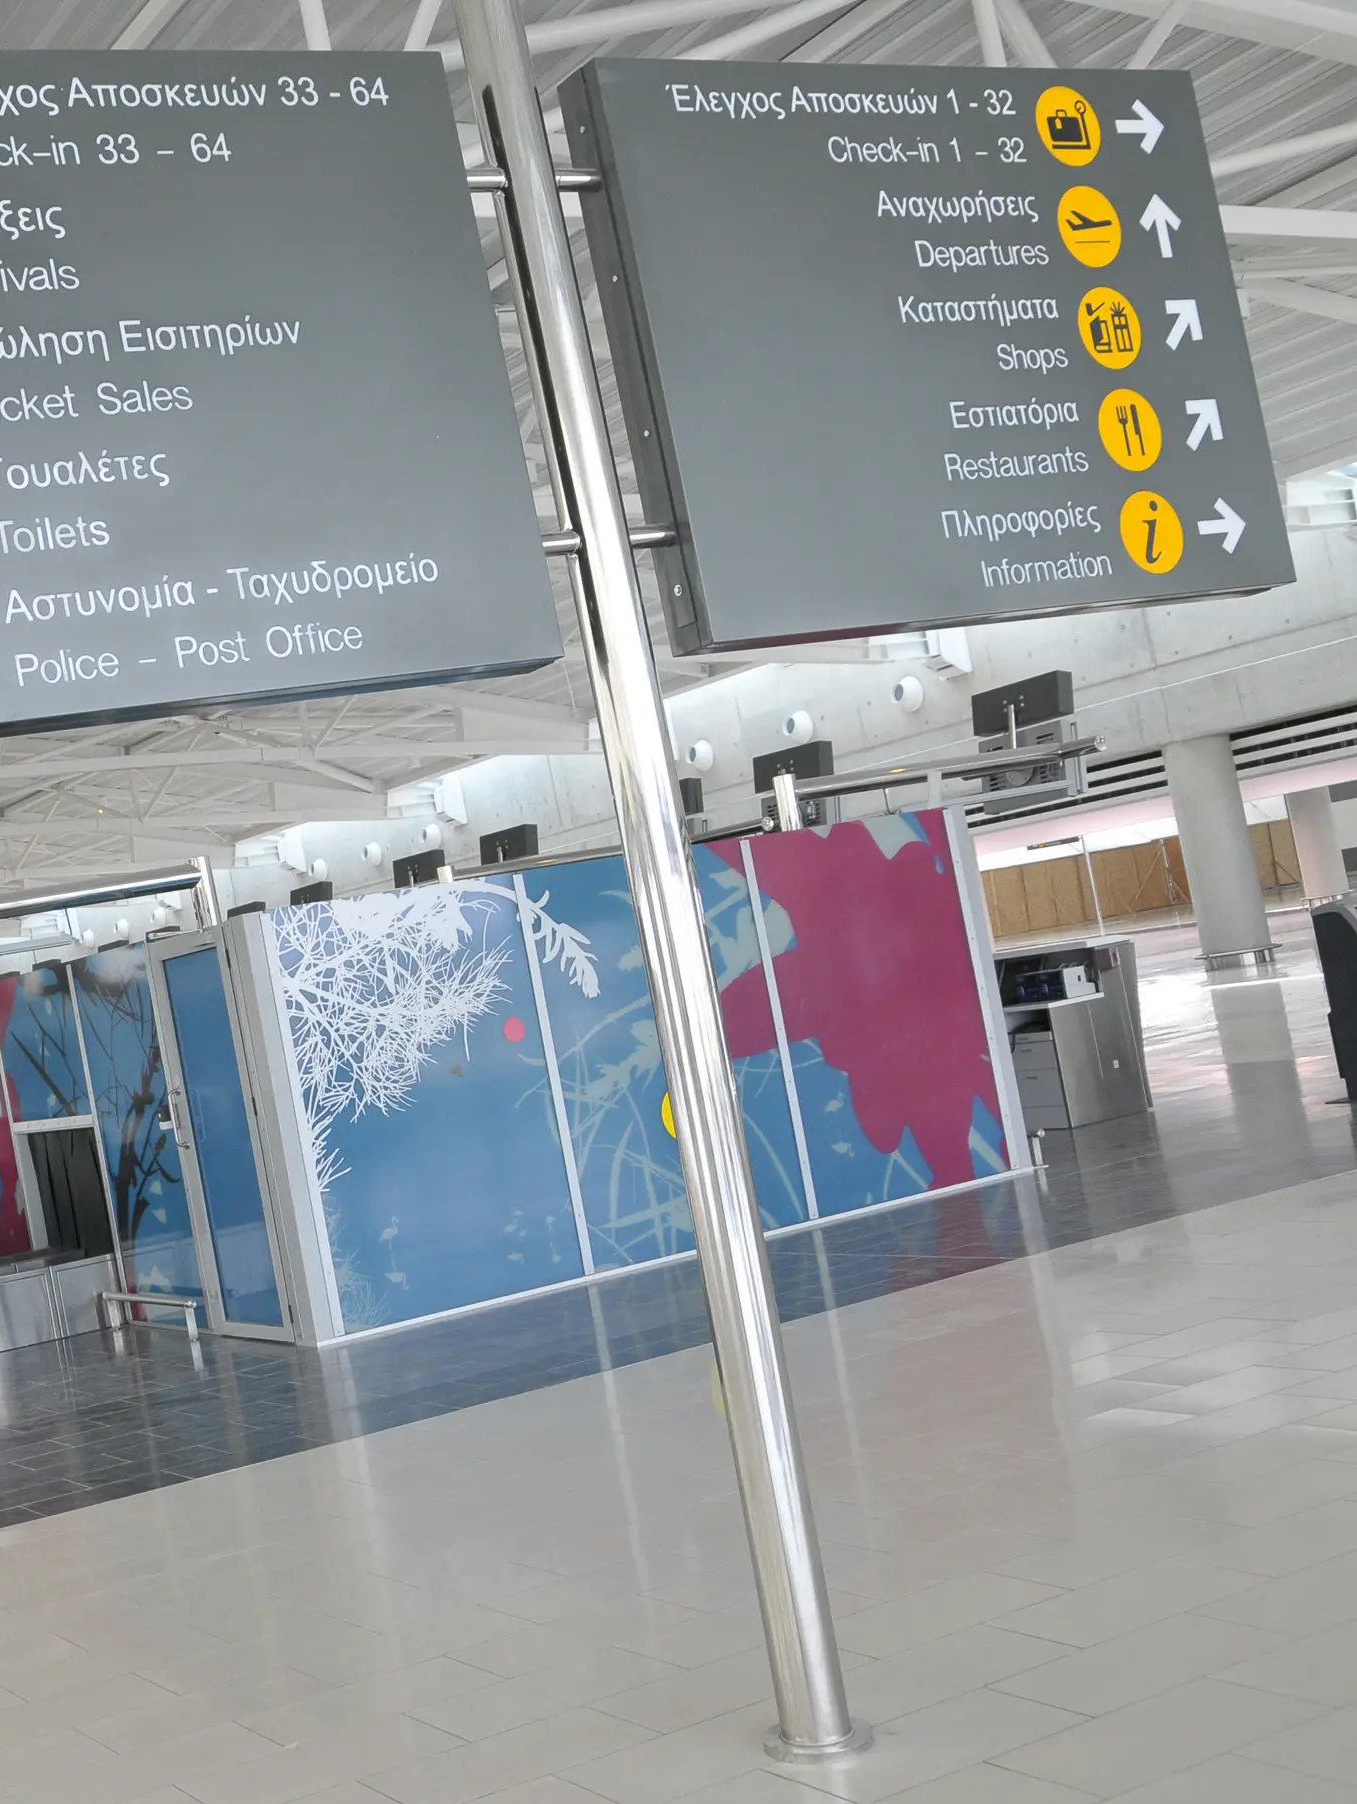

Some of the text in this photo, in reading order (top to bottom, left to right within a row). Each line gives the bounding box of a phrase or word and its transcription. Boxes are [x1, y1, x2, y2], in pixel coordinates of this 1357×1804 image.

[68, 76, 266, 108] Αποσκευών
[278, 76, 318, 106] 33
[350, 77, 389, 106] 64
[665, 84, 785, 120] Έλεγχος
[791, 86, 937, 115] Αποσκευών
[947, 89, 959, 115] 1
[984, 89, 1016, 115] 32
[96, 134, 139, 164] 33
[191, 133, 231, 162] 64
[828, 136, 939, 163] Check-in
[949, 137, 961, 163] 1
[998, 137, 1027, 163] 32
[878, 190, 1039, 224] Αναχωρήσεις
[914, 239, 1049, 273] Departures
[898, 293, 1059, 326] Καταστήματα
[119, 315, 299, 355] Εισιτηρίων
[997, 344, 1068, 374] Shops
[97, 381, 193, 414] Sales
[950, 397, 1079, 430] Εστιατόρια
[944, 446, 1089, 480] Restaurants
[941, 501, 1101, 542] Πληροφορίες
[981, 552, 1112, 587] Information
[6, 575, 195, 625] Αστυνομία
[226, 553, 438, 606] Ταχυδρομείο
[15, 650, 119, 686] Police
[175, 631, 250, 668] Post
[266, 624, 362, 657] Office
